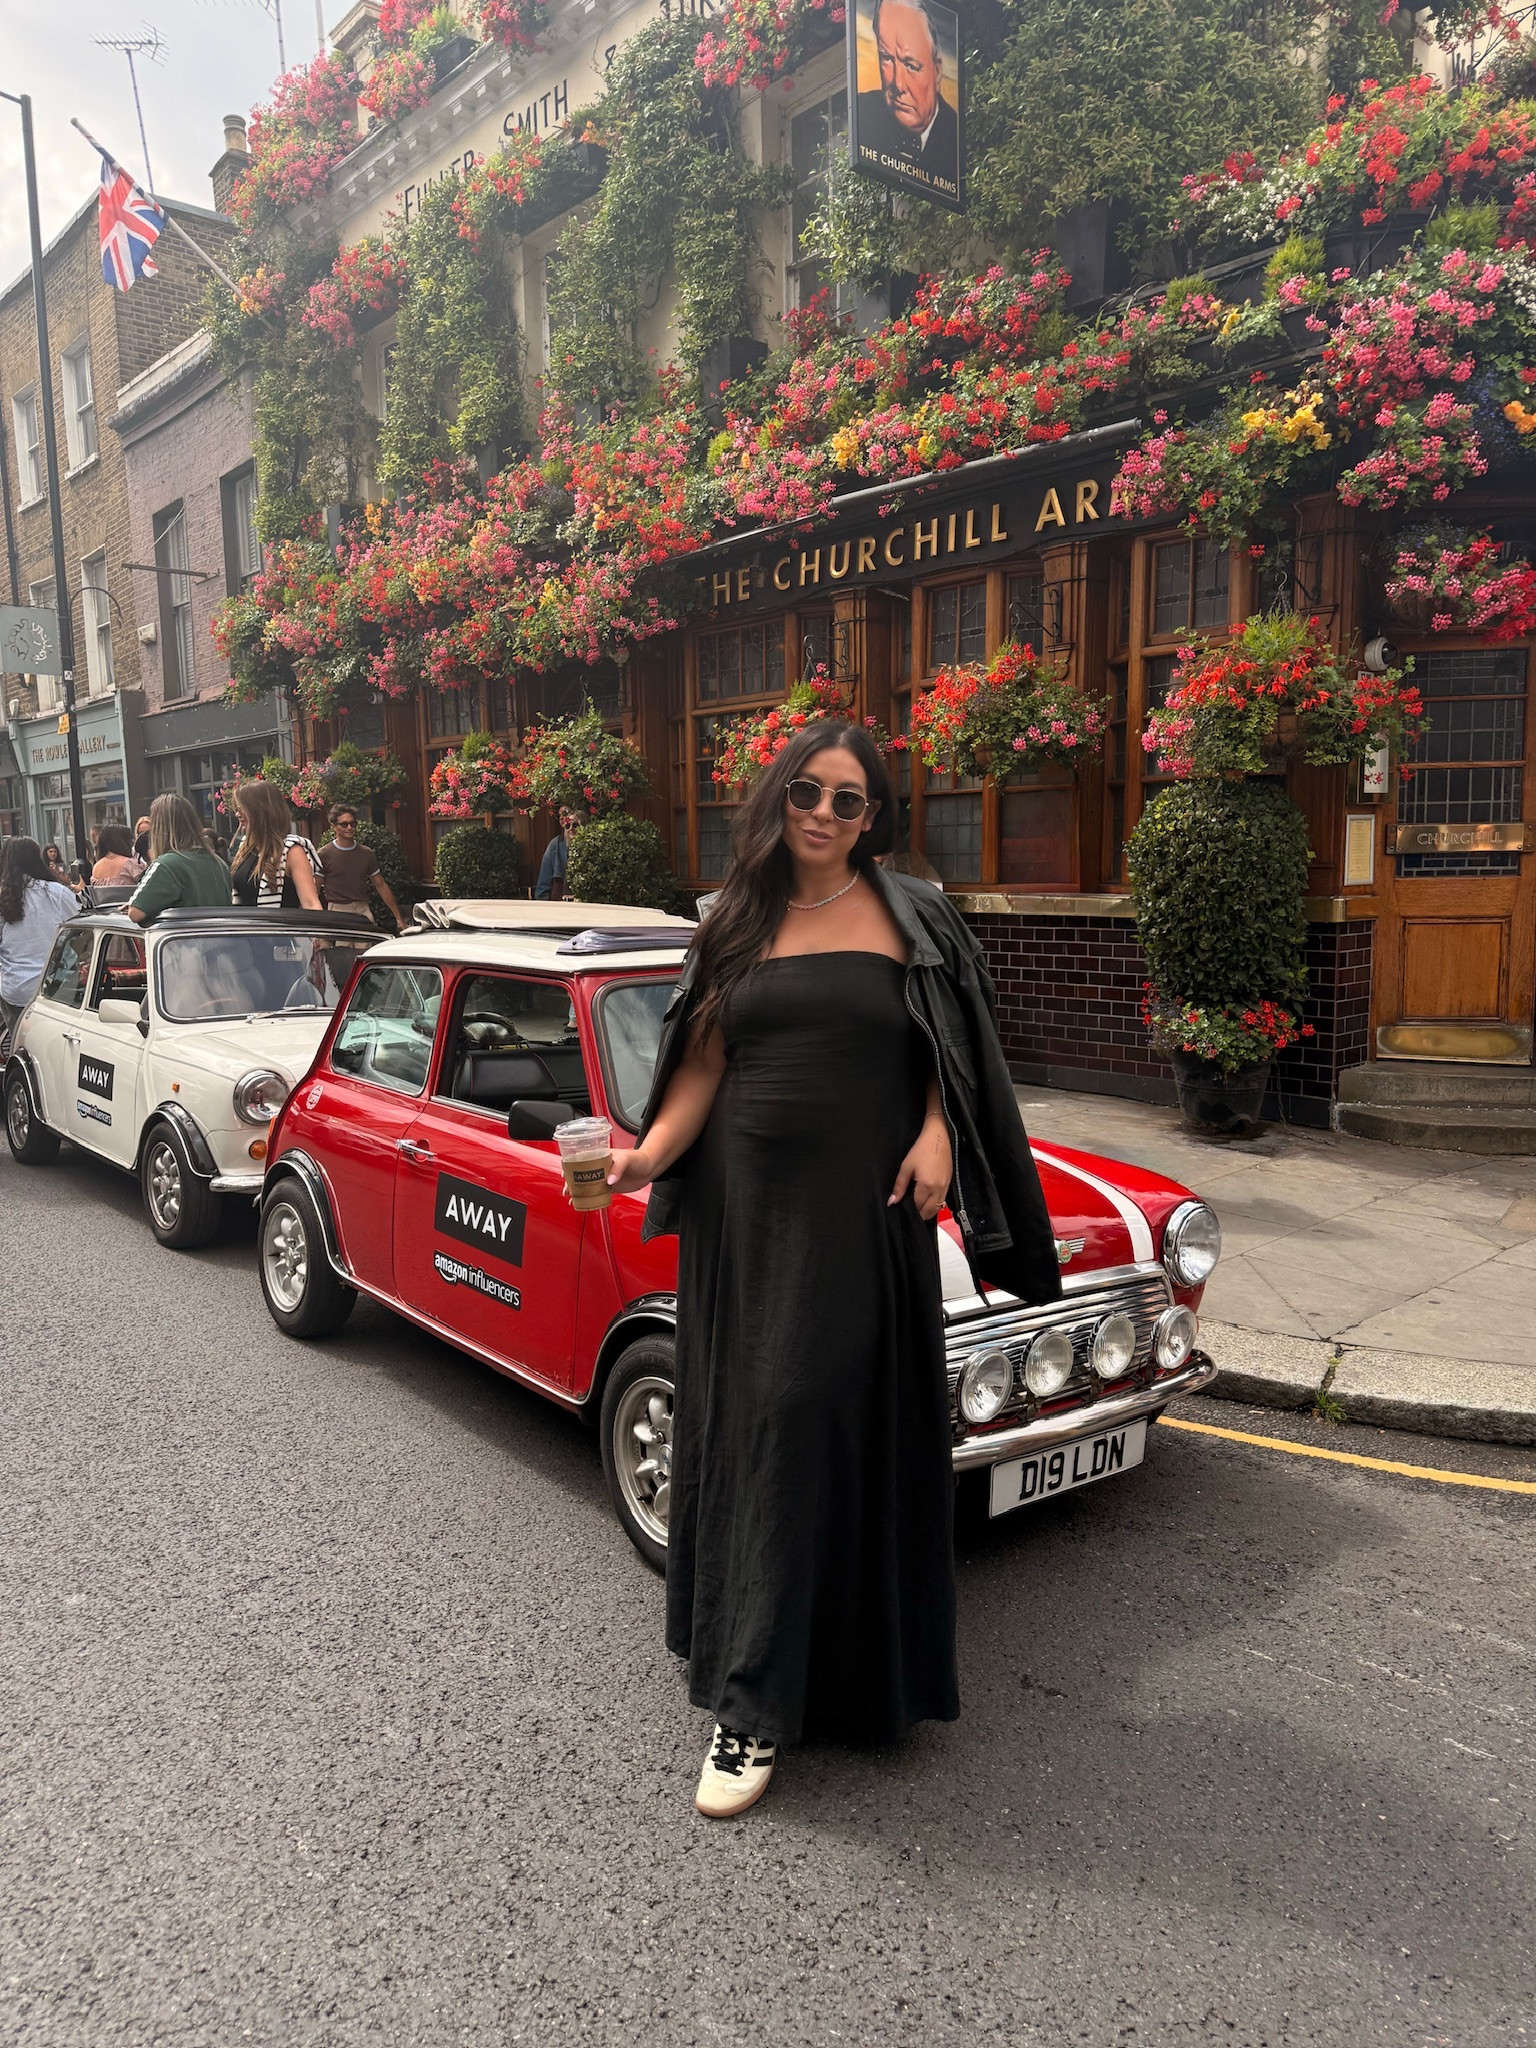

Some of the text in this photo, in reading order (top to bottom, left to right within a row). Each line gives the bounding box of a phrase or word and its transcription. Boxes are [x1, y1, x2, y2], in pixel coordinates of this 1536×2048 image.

[860, 145, 957, 194] THE CHURCHILL ARMS
[772, 503, 1008, 591] CHURCHILL
[32, 747, 44, 764] THE
[45, 743, 68, 761] ROWLE
[79, 735, 106, 755] ALLERY
[1416, 831, 1503, 845] CHURCHILL
[82, 1064, 110, 1088] AWAY
[577, 1171, 602, 1180] AWAY
[445, 1194, 513, 1242] AWAY
[434, 1253, 520, 1306] amazon influencers
[1019, 1432, 1126, 1501] D19 LDN
